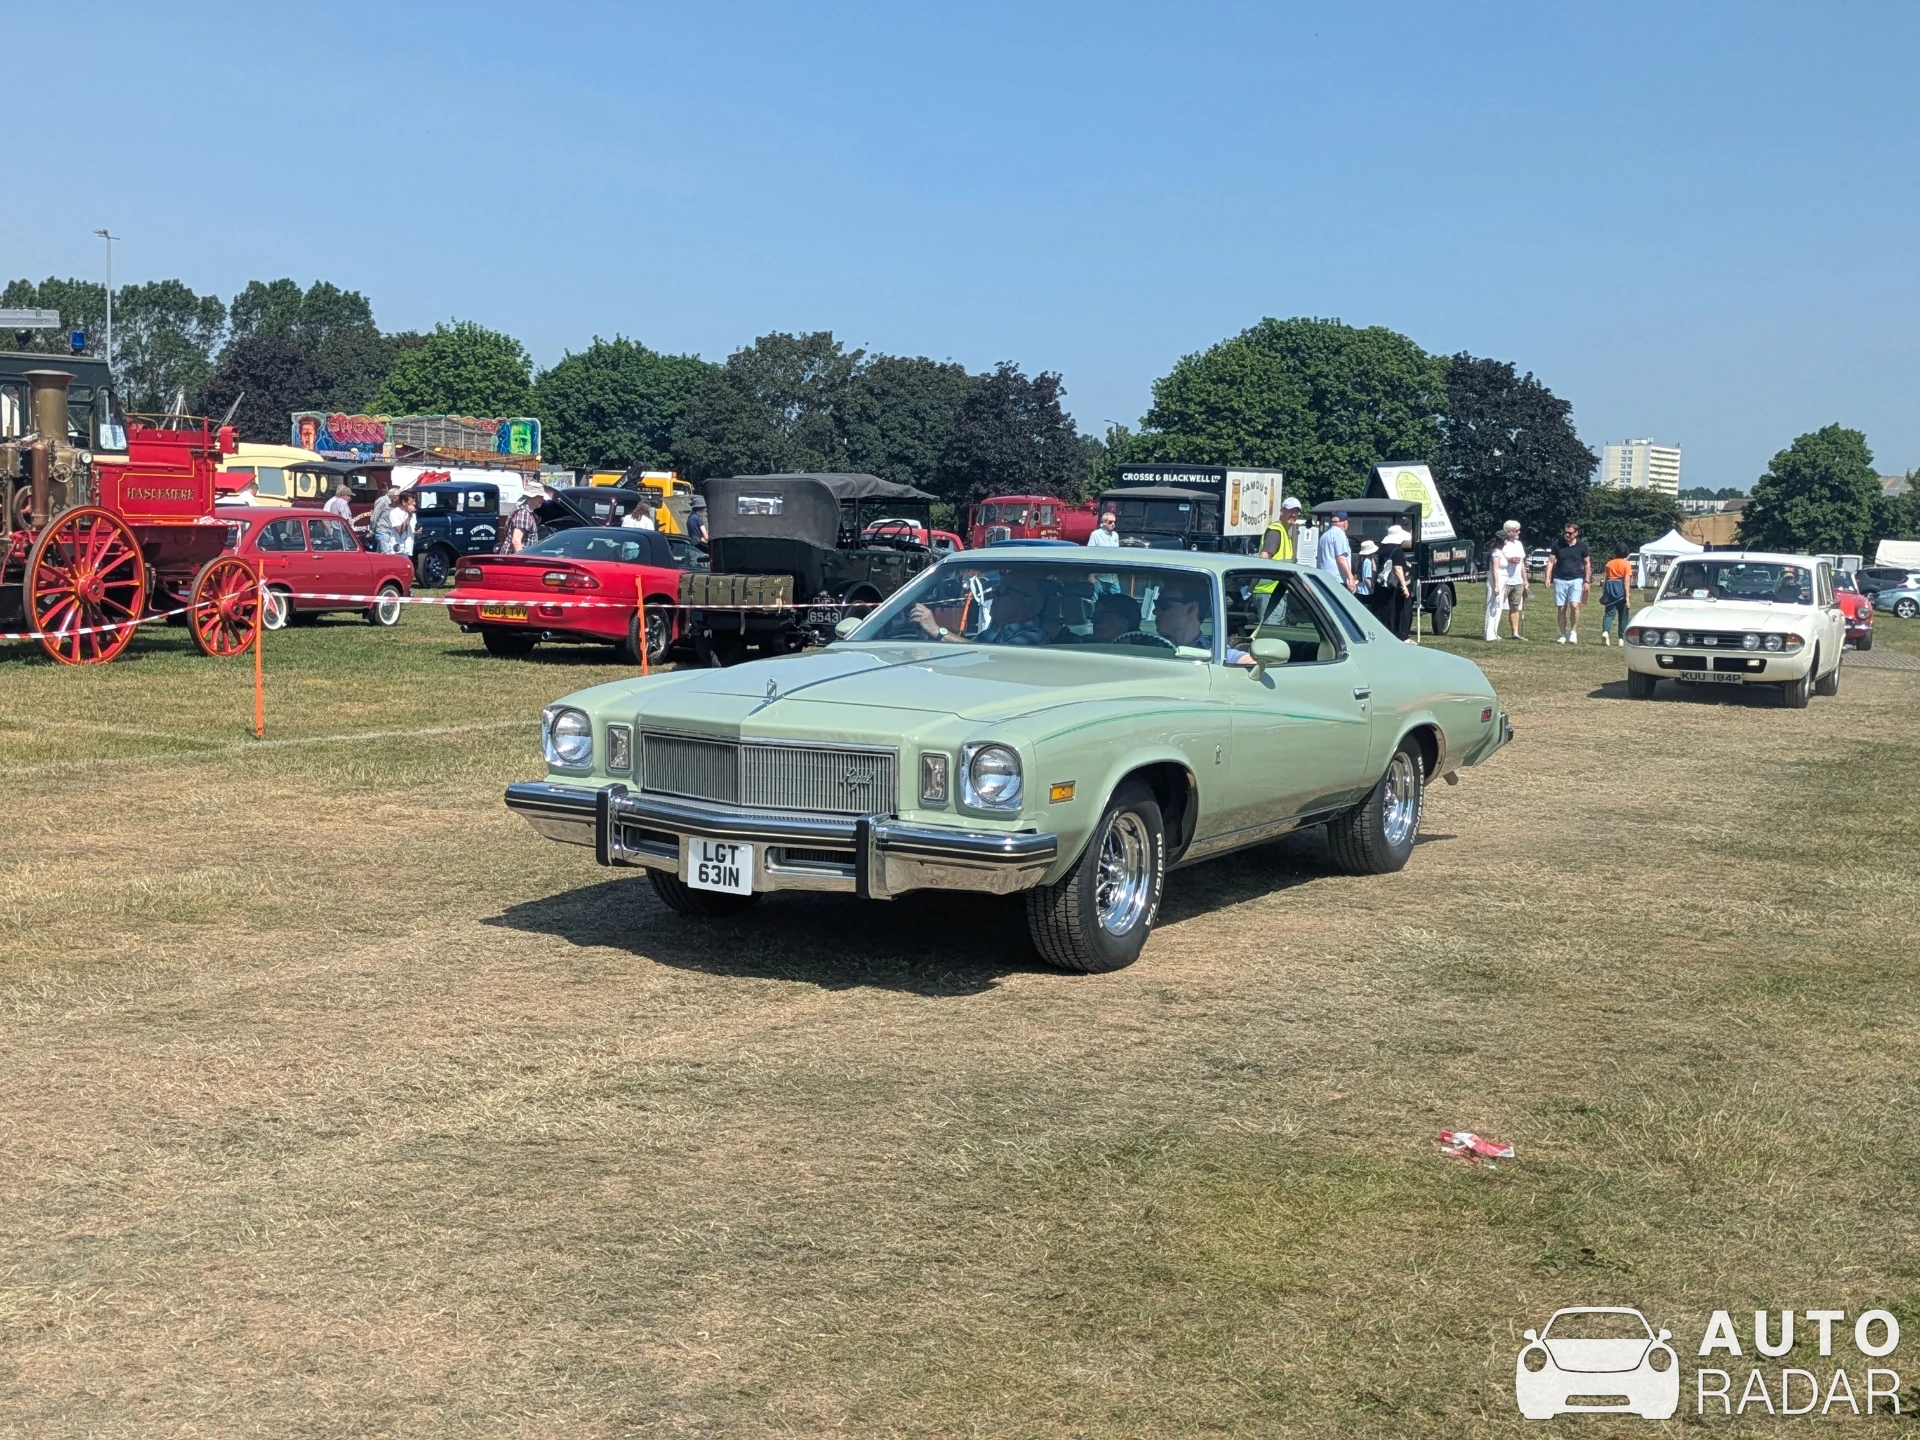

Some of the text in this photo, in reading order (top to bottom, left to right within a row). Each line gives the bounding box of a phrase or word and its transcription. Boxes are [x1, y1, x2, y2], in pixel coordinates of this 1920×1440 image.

[1122, 472, 1154, 481] CROSSE
[1155, 473, 1162, 482] &
[1163, 473, 1210, 483] BLACKWELL
[126, 487, 195, 501] HASLEMERE
[1242, 480, 1268, 496] FAMOUS
[1241, 510, 1267, 526] PRODUCTS
[482, 605, 528, 618] V604 TVV
[810, 611, 839, 623] 6543
[1681, 671, 1742, 683] KUU 184P
[702, 841, 739, 865] LGT
